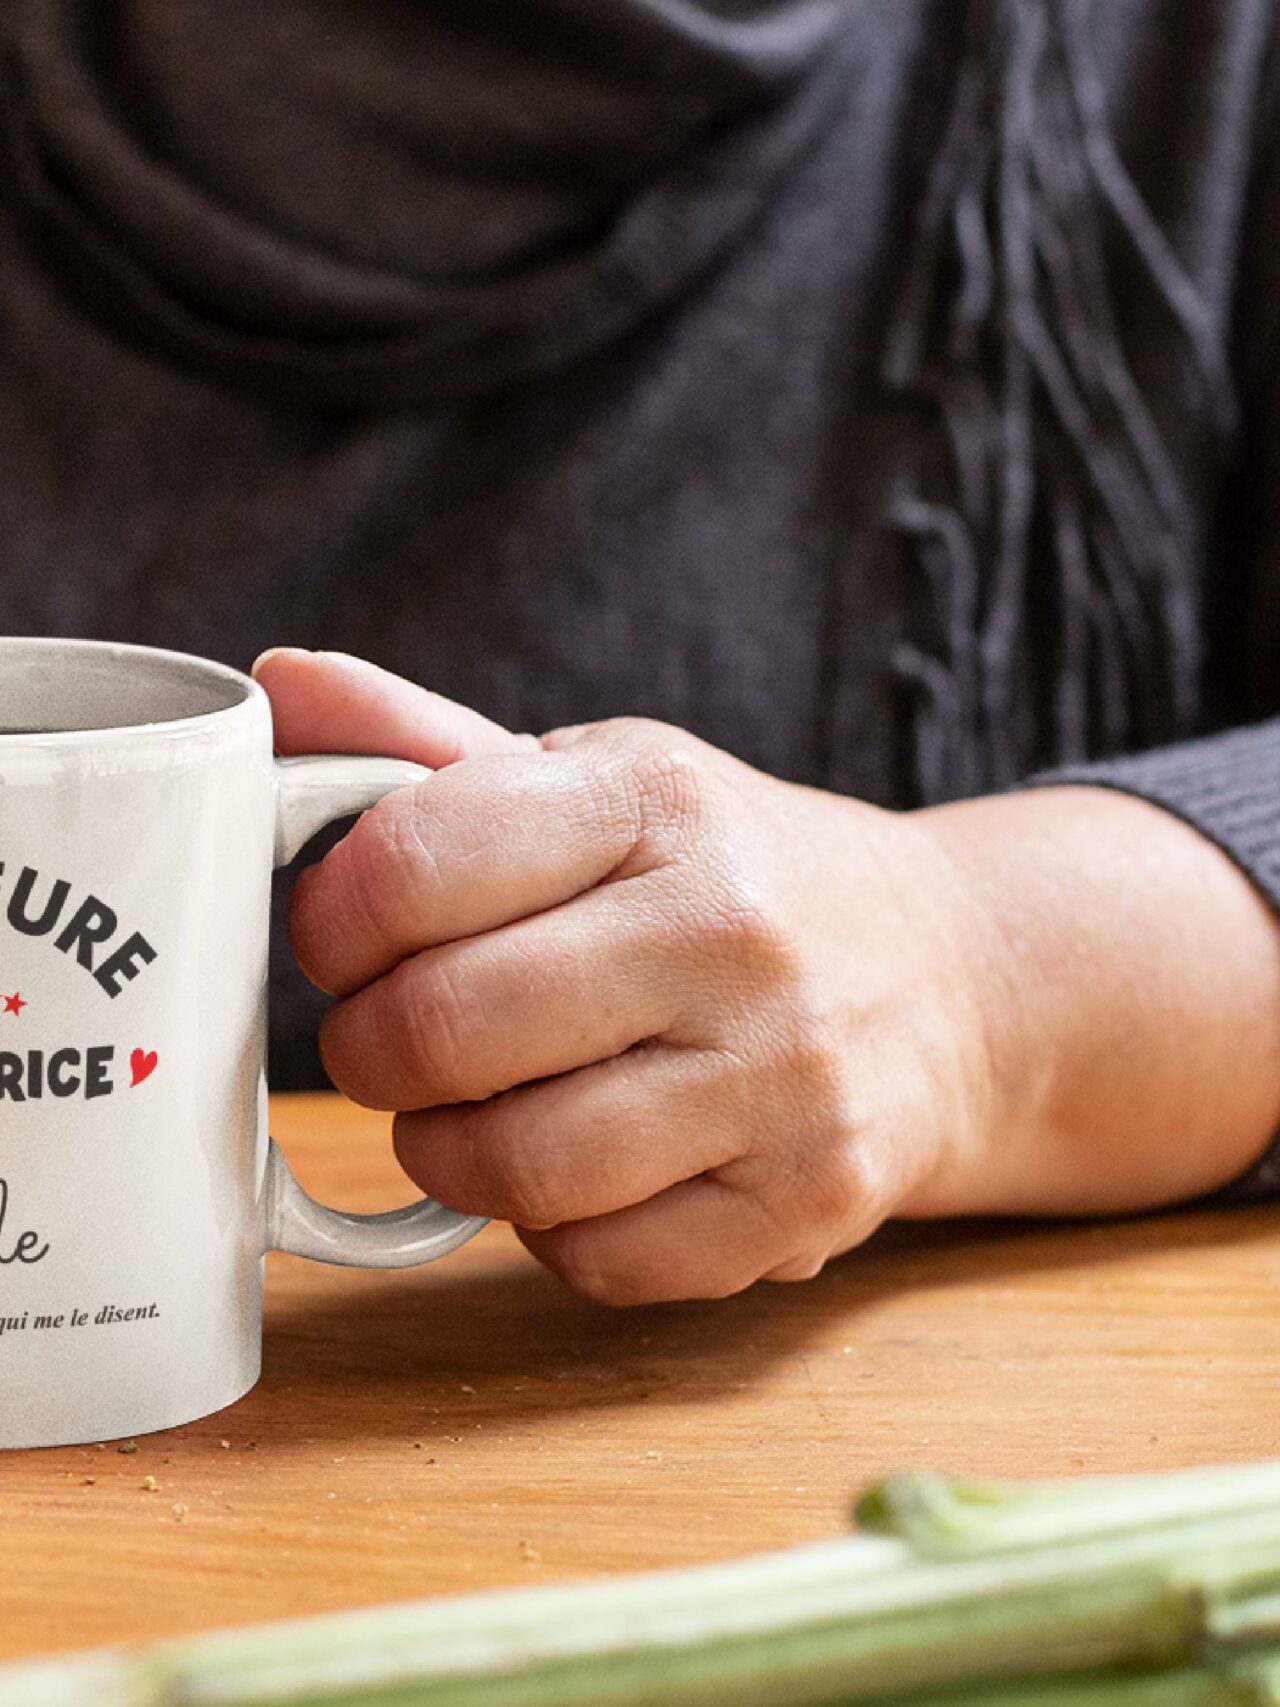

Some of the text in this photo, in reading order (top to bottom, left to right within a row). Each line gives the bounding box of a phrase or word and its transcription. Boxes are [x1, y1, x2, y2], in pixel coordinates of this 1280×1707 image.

[33, 1315, 65, 1330] me
[70, 1308, 89, 1327] le
[94, 1303, 160, 1325] disent.
